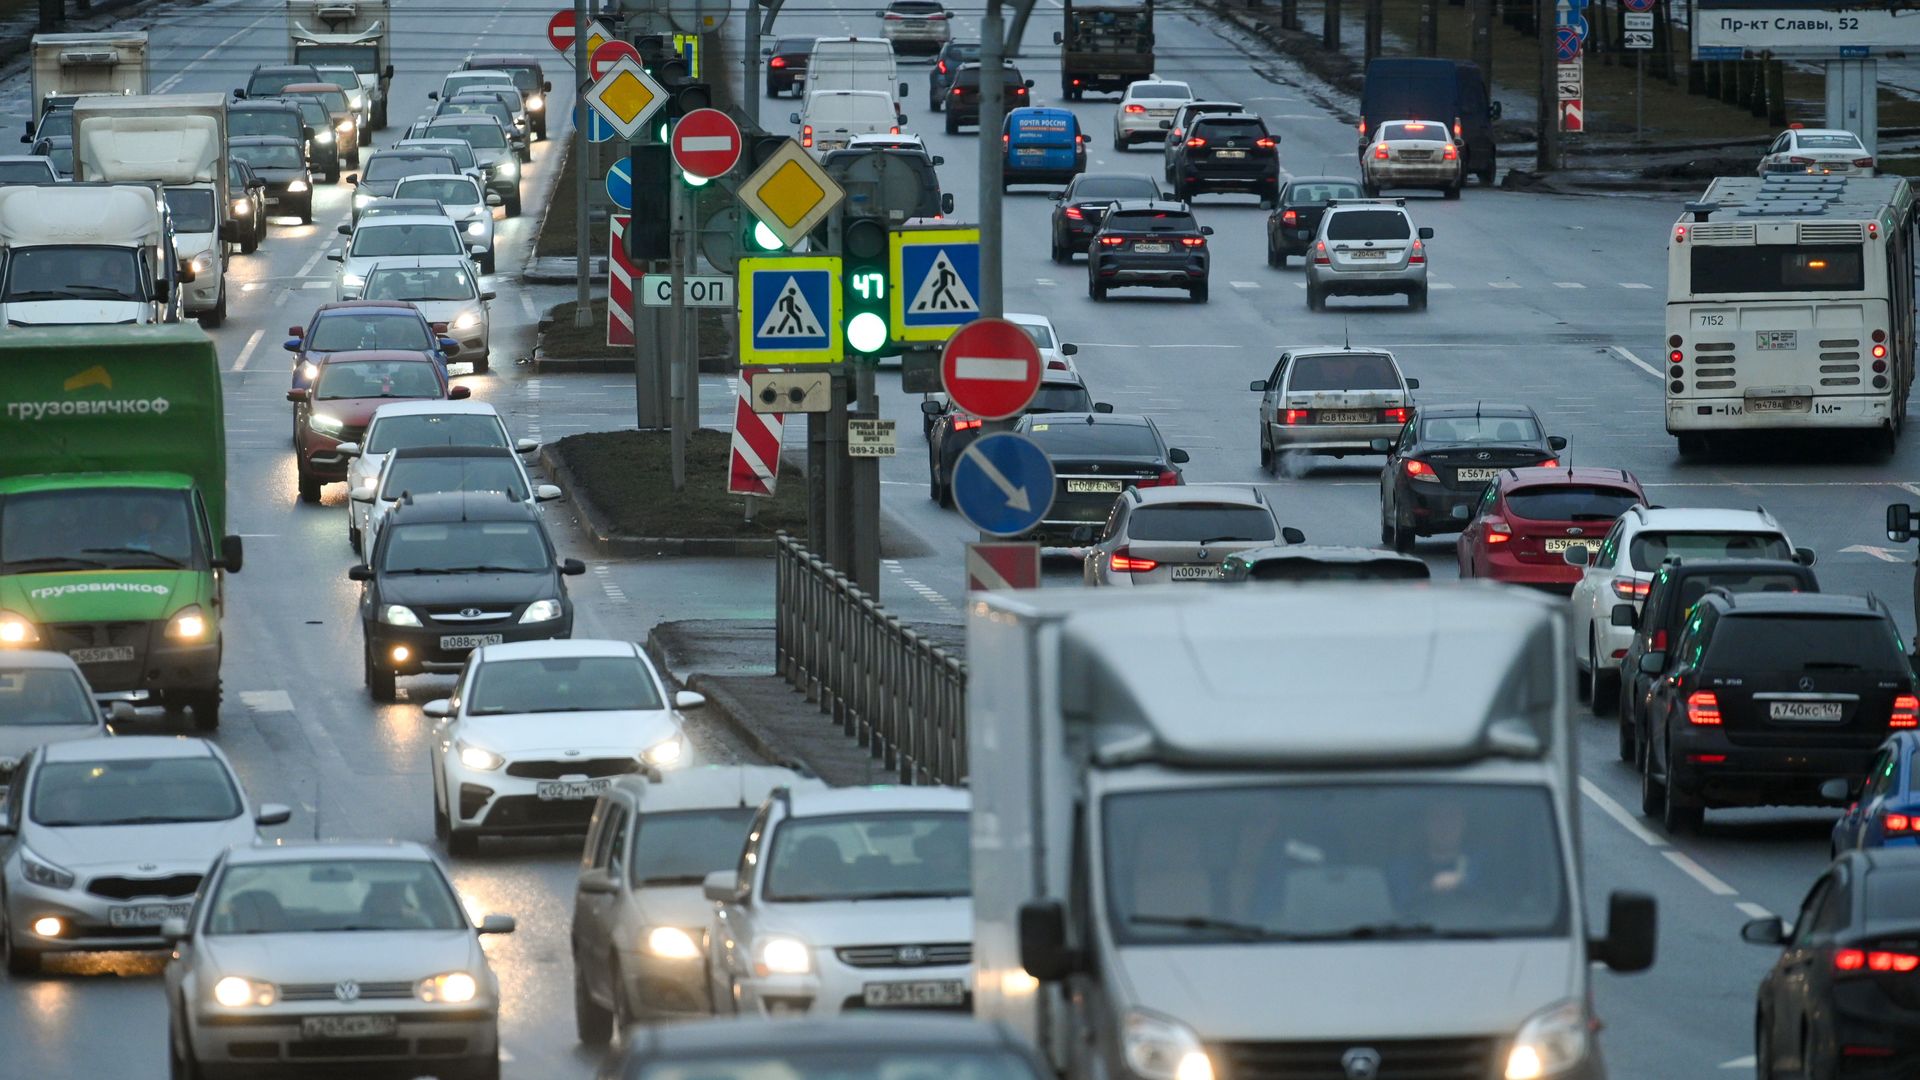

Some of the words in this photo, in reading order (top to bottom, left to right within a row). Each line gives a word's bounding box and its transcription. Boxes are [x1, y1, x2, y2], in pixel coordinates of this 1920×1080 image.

[1720, 17, 1769, 33] Пр-кт
[1774, 17, 1834, 32] Славы,
[1838, 17, 1859, 30] 52
[1019, 119, 1040, 127] ПОЧТА
[1041, 119, 1066, 127] РОССИИ
[657, 281, 723, 301] СОП
[853, 273, 884, 299] 47
[1700, 315, 1724, 326] 7152
[7, 397, 170, 420] грузовичкоф
[850, 446, 895, 454] 989-2-888
[31, 583, 169, 598] грузовичкоф
